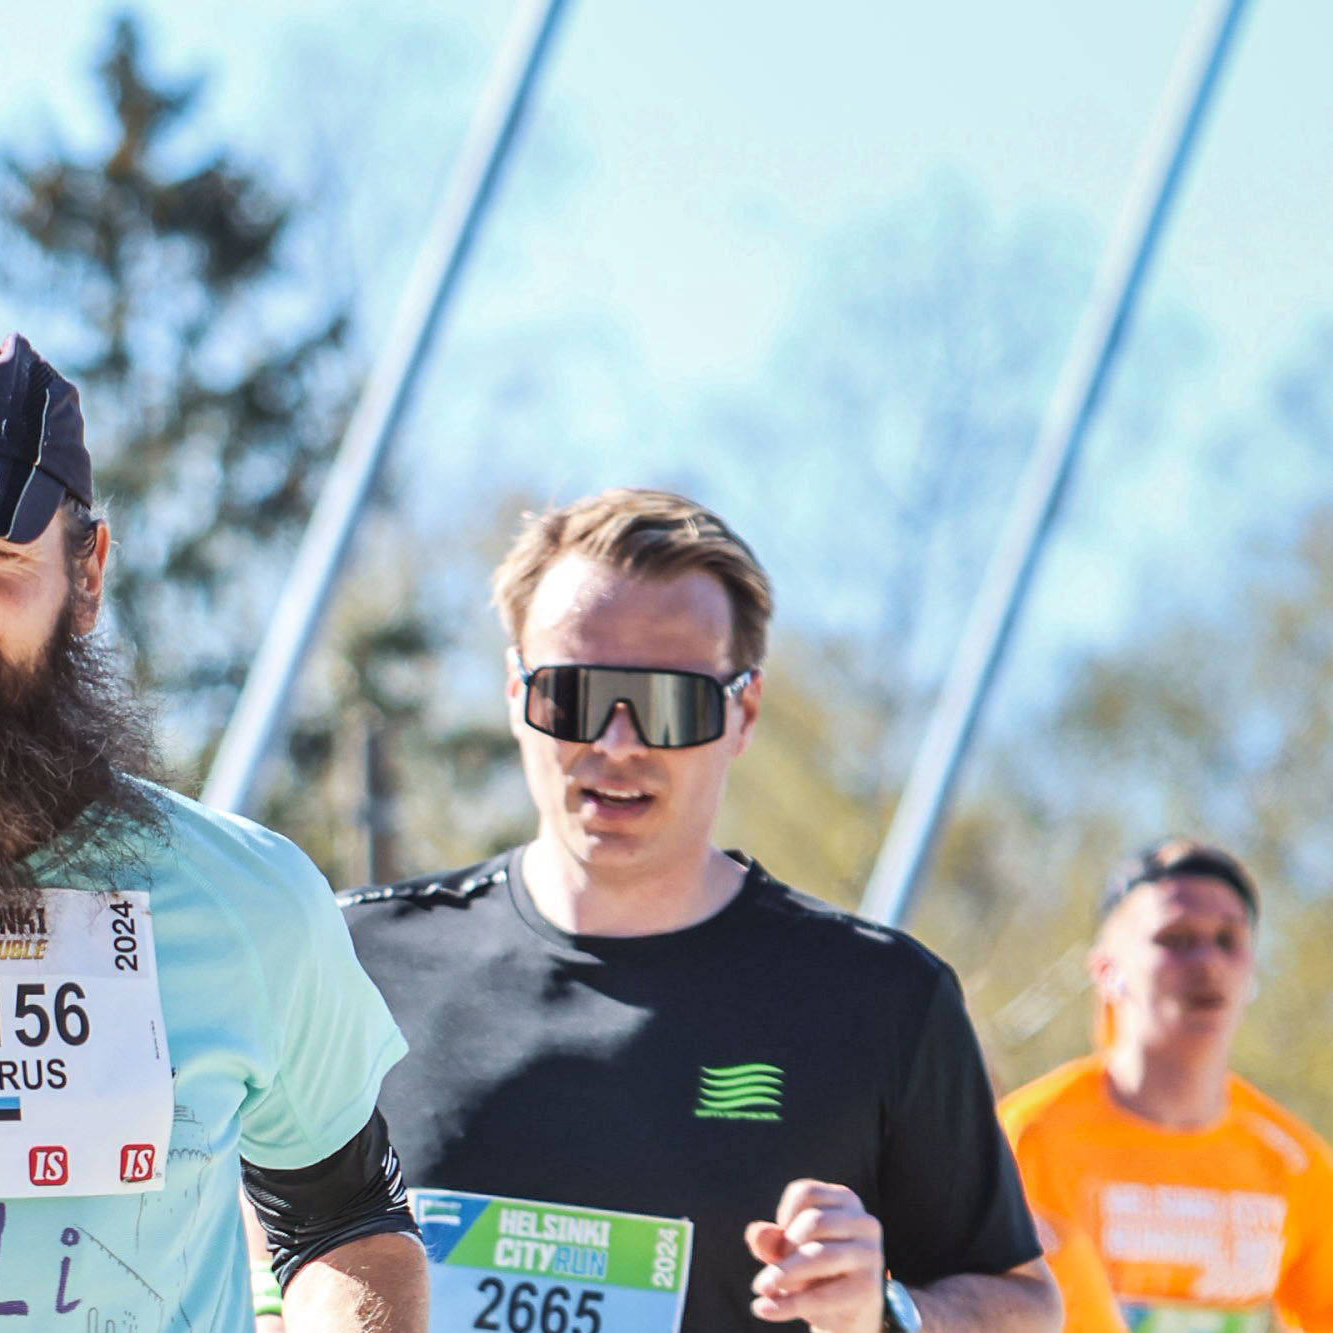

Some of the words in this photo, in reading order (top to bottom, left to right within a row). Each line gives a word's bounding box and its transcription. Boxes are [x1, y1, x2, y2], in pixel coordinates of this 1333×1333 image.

[110, 900, 138, 972] 2024
[499, 1208, 611, 1248] HELSINKI
[651, 1228, 679, 1288] 2024
